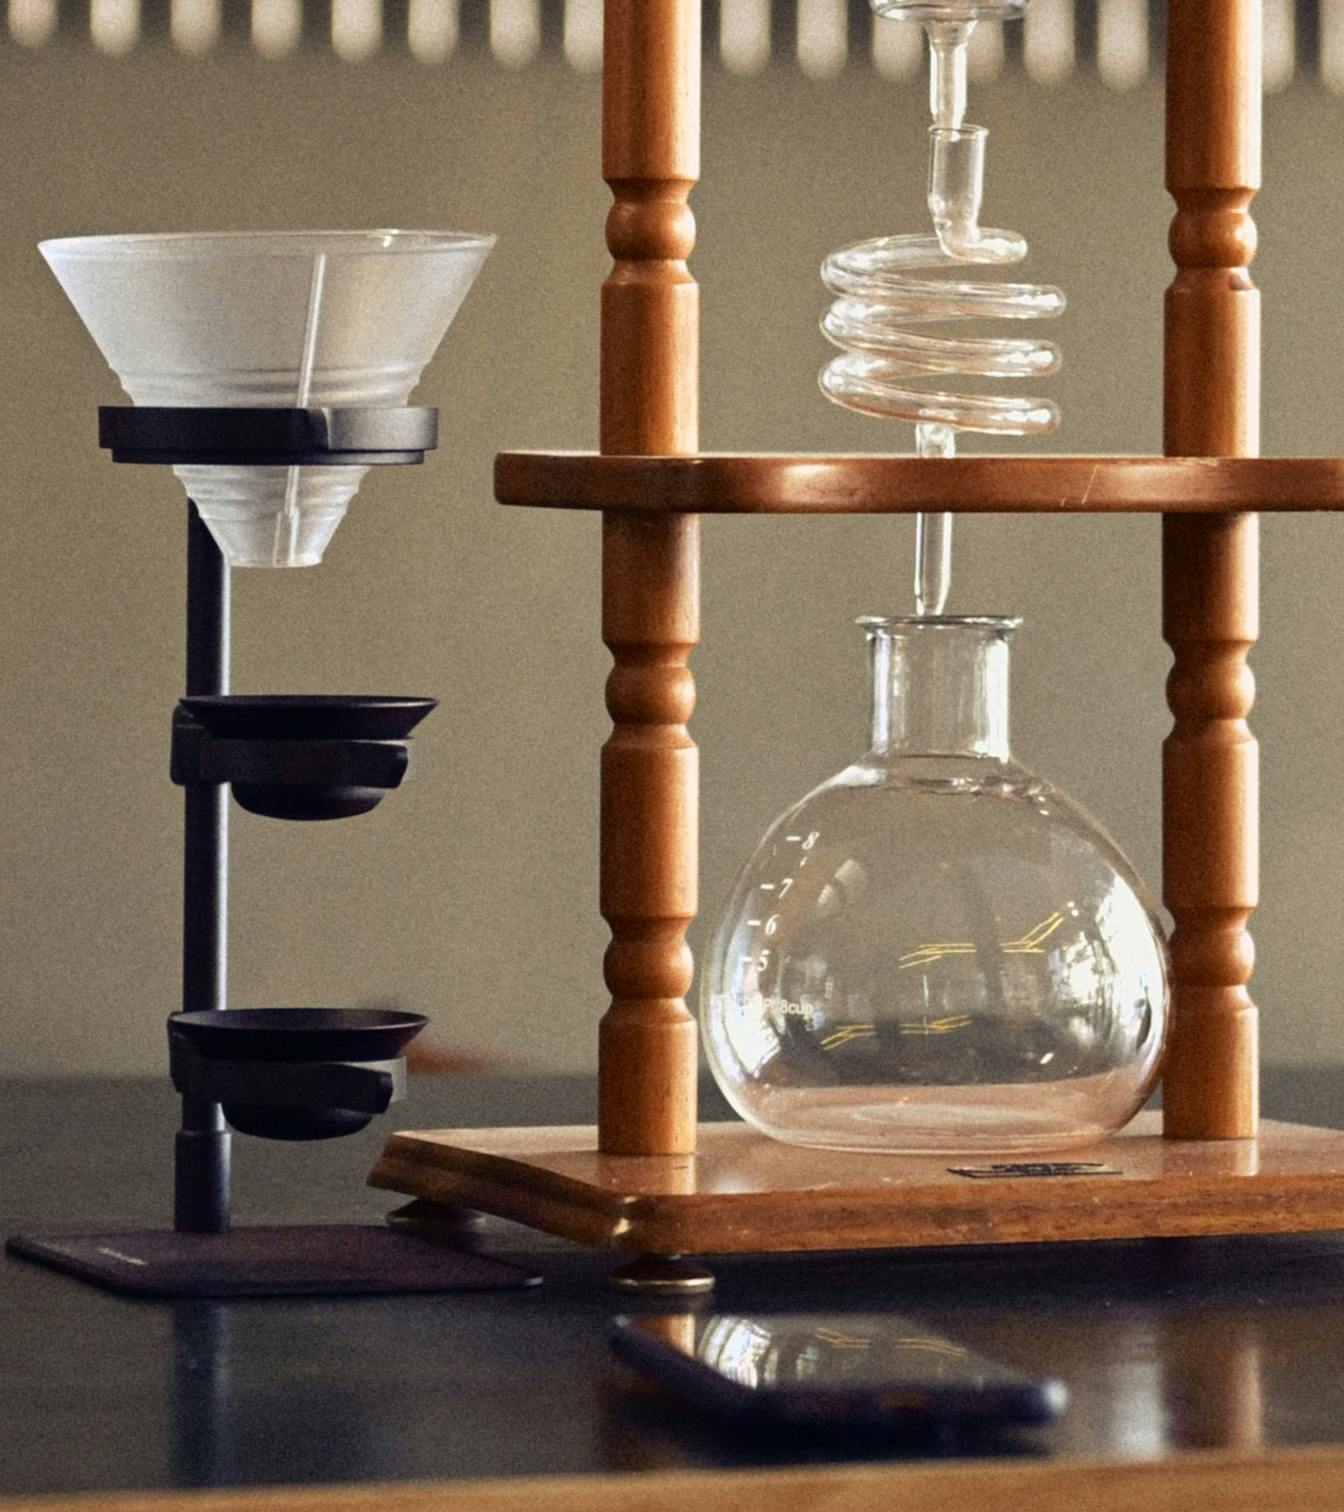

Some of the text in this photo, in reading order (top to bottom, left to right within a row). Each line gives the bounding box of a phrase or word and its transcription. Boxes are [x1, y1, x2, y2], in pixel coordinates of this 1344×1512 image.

[802, 831, 820, 850] 8
[778, 878, 793, 898] 7
[764, 913, 780, 936] 6
[757, 949, 771, 972] 5
